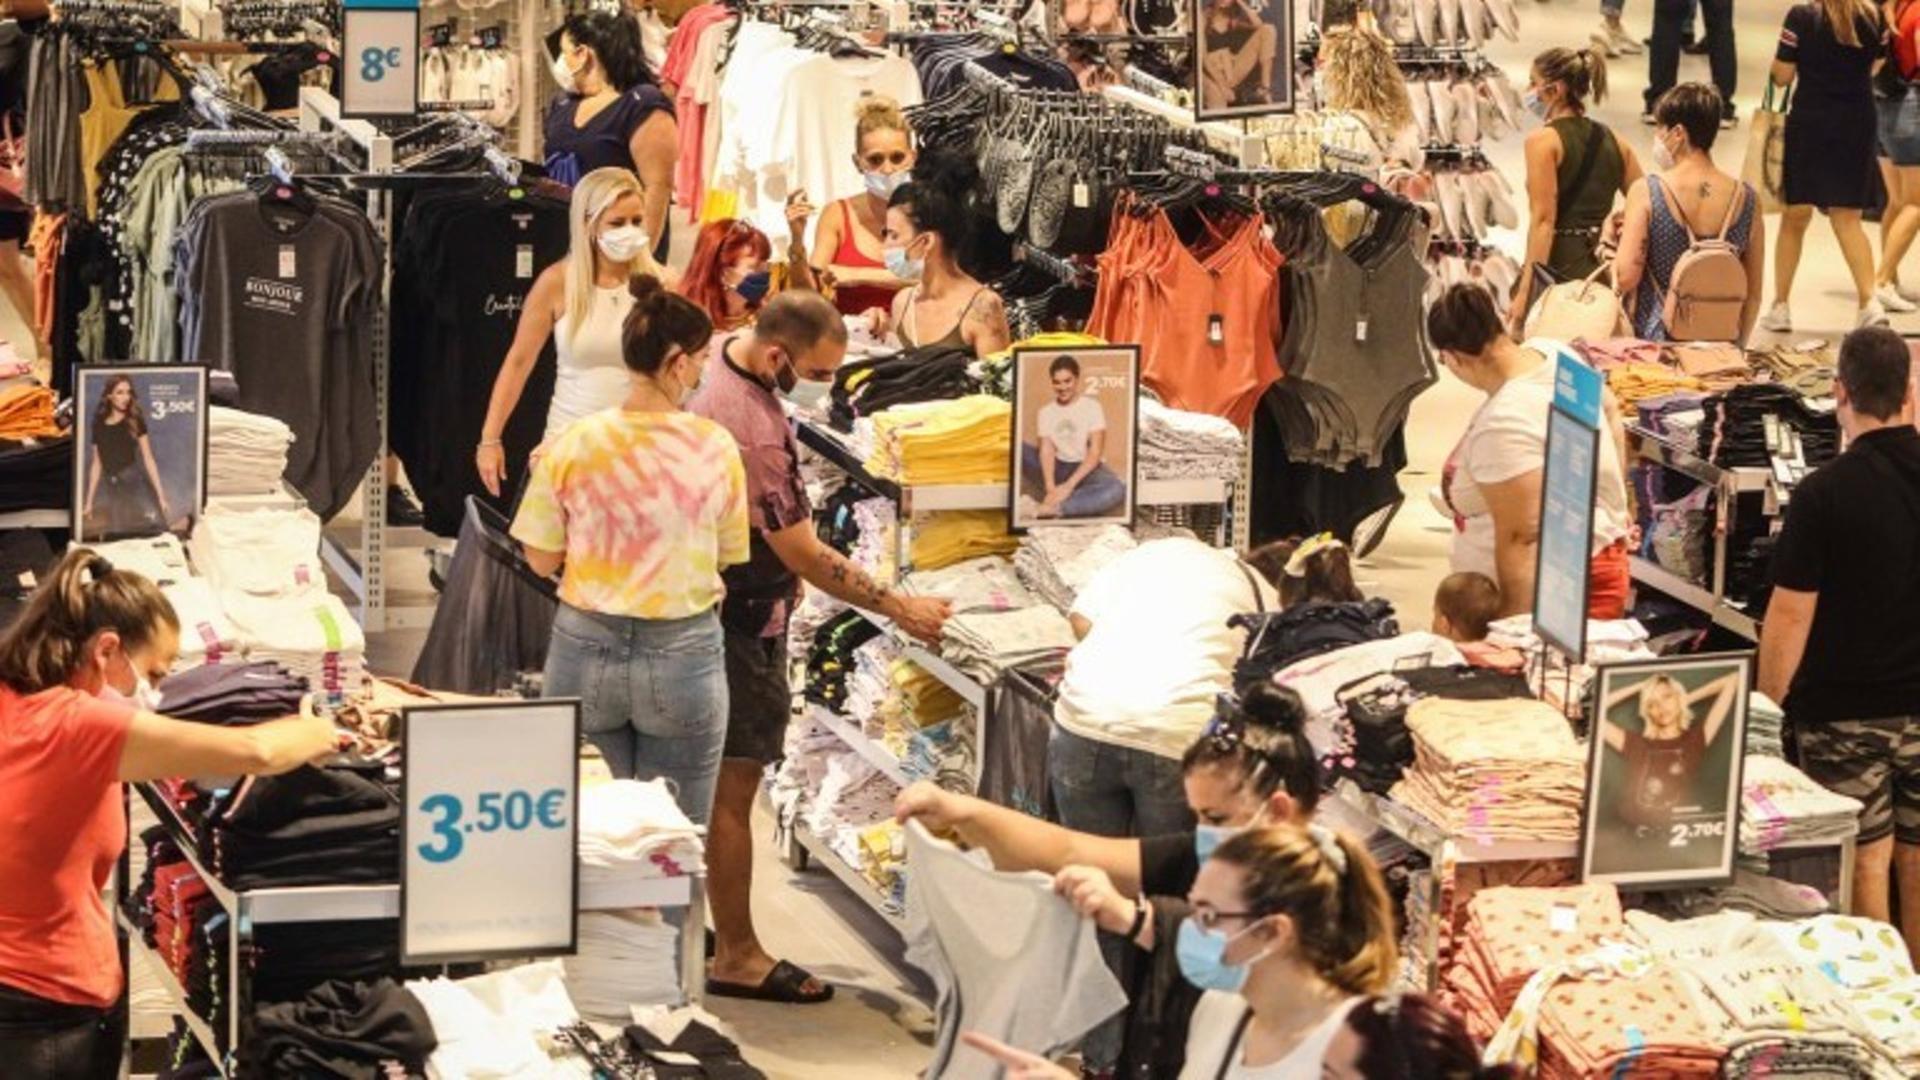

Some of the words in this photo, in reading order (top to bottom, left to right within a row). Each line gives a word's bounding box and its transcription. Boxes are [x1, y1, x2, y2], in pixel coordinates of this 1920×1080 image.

[361, 46, 401, 82] 8€
[151, 400, 195, 420] 3.50€
[417, 788, 567, 863] 3.50€
[1669, 821, 1725, 847] 2.70€
